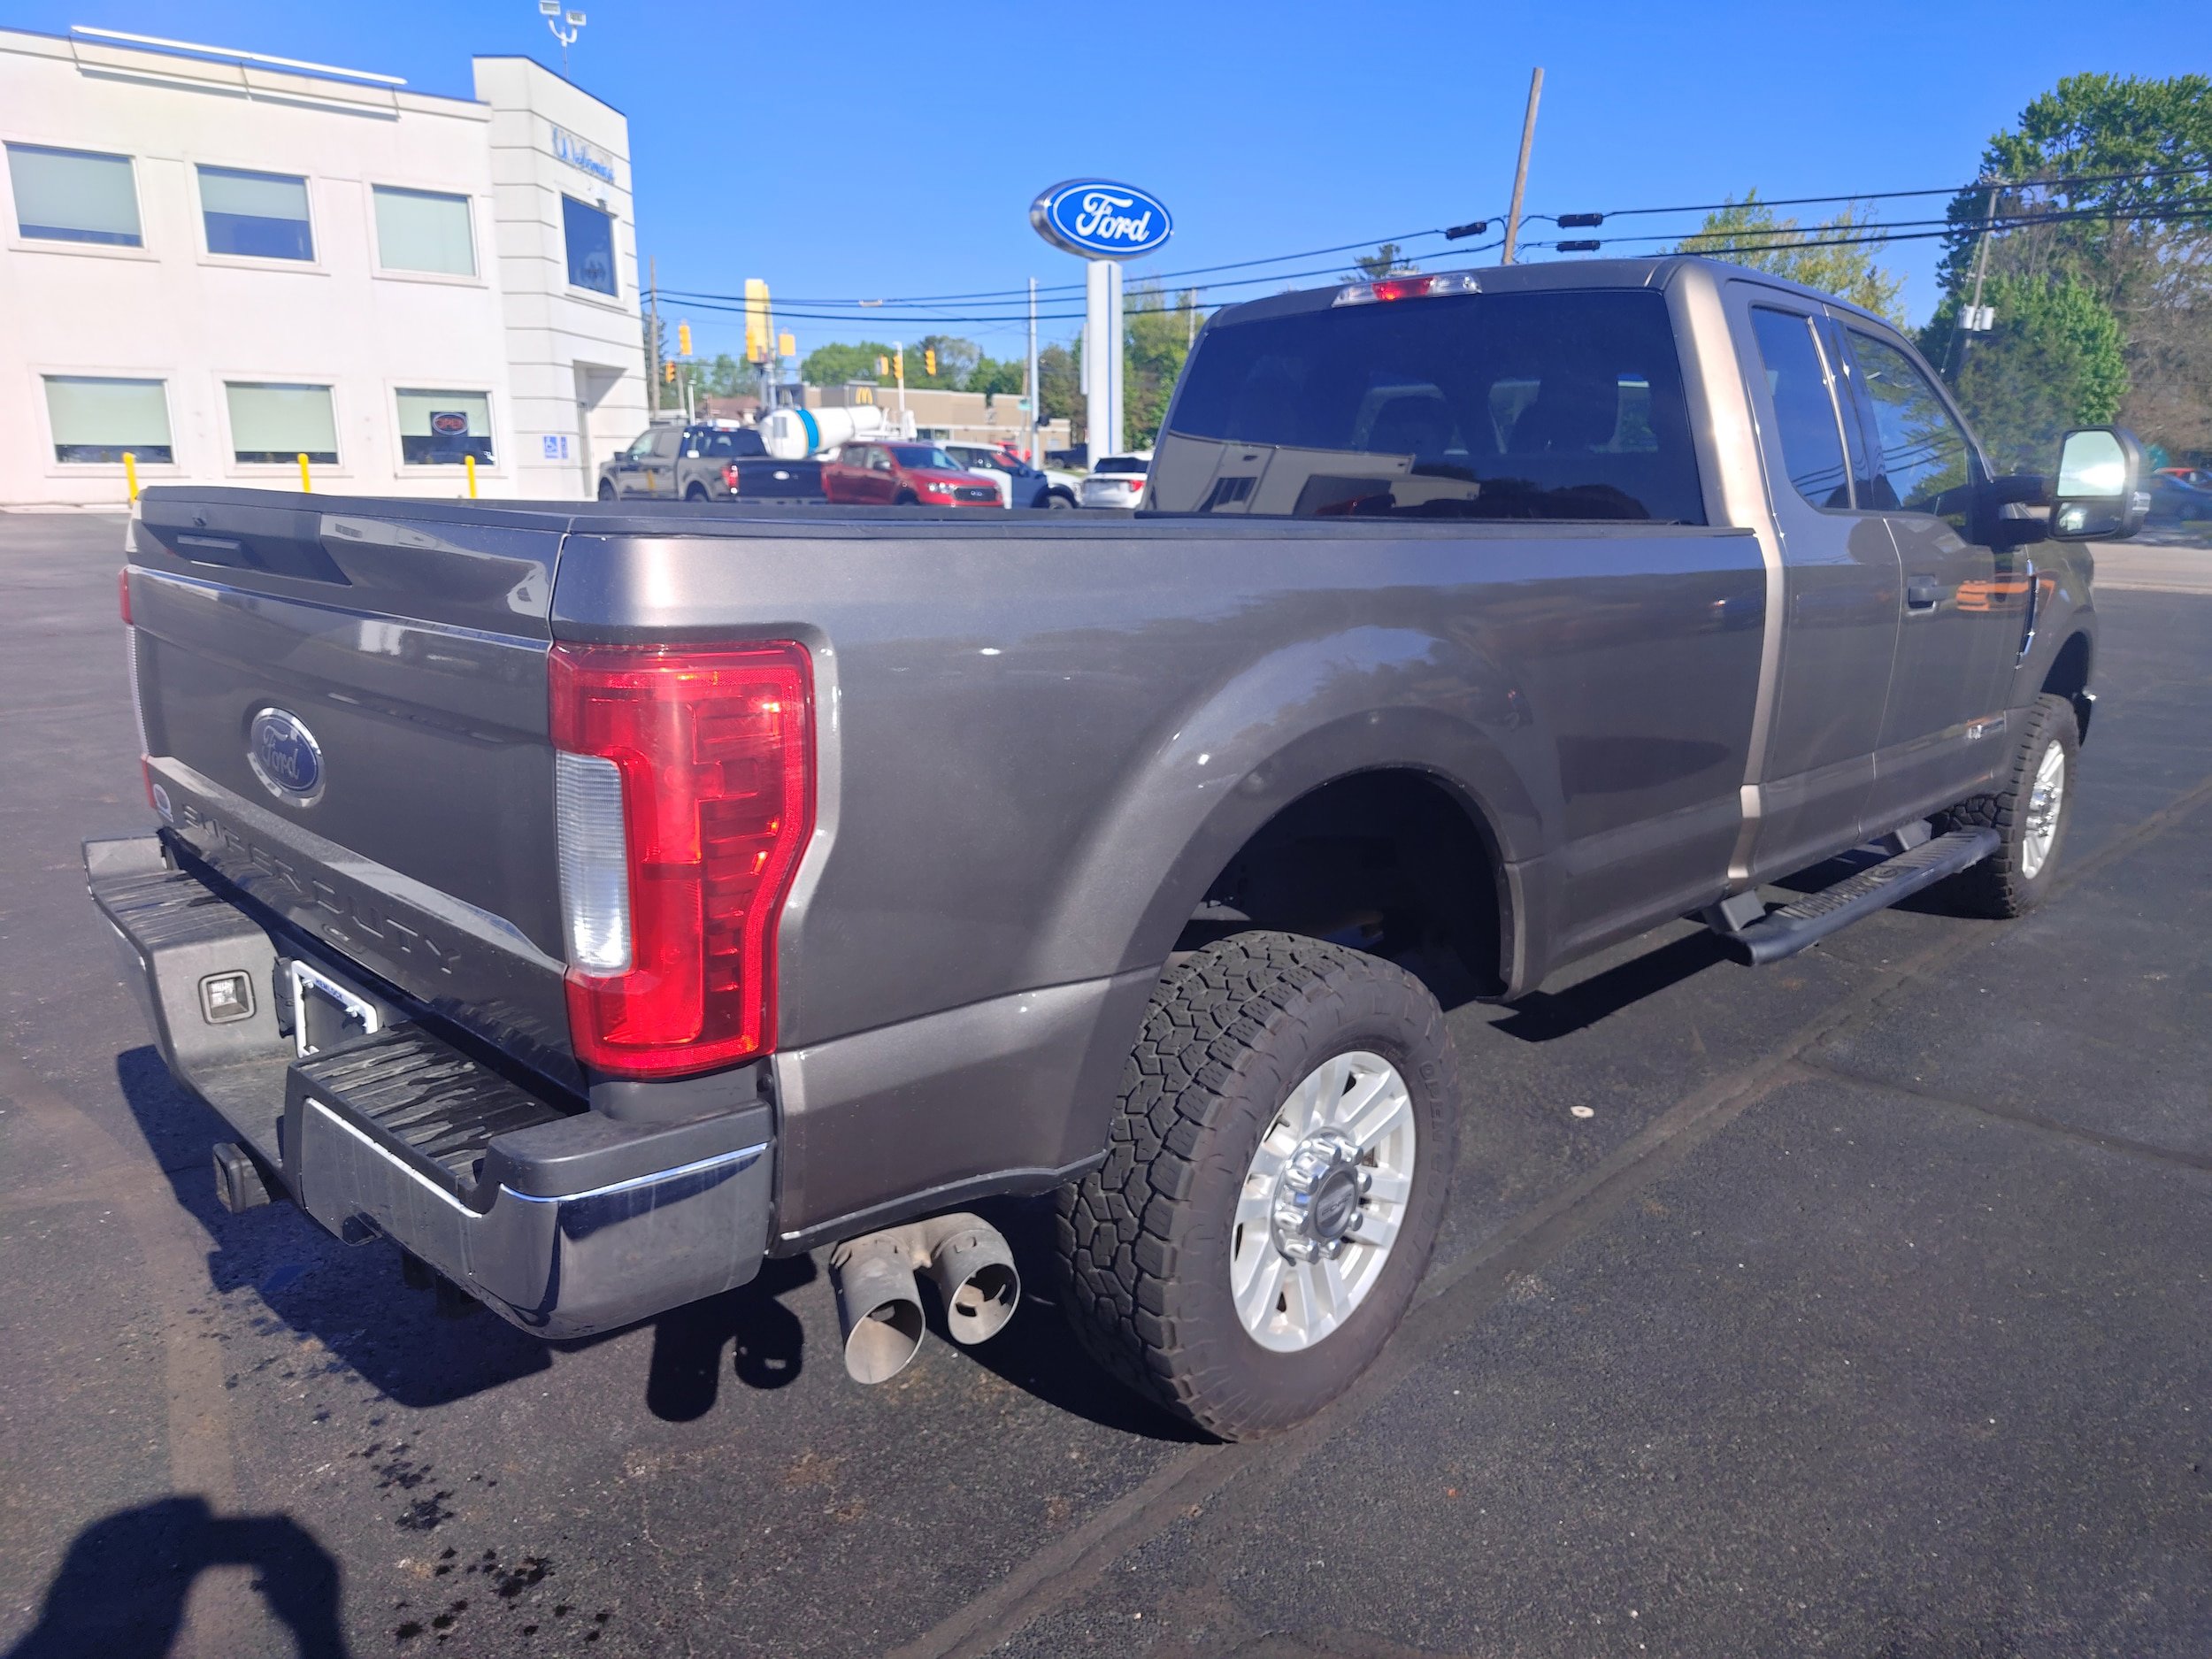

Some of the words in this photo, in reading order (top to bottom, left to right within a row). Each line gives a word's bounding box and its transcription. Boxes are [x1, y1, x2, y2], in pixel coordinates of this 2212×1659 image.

[1075, 192, 1152, 242] Ford
[262, 725, 300, 780] Ford
[182, 803, 303, 894] SUPER
[312, 879, 463, 975] DUTY
